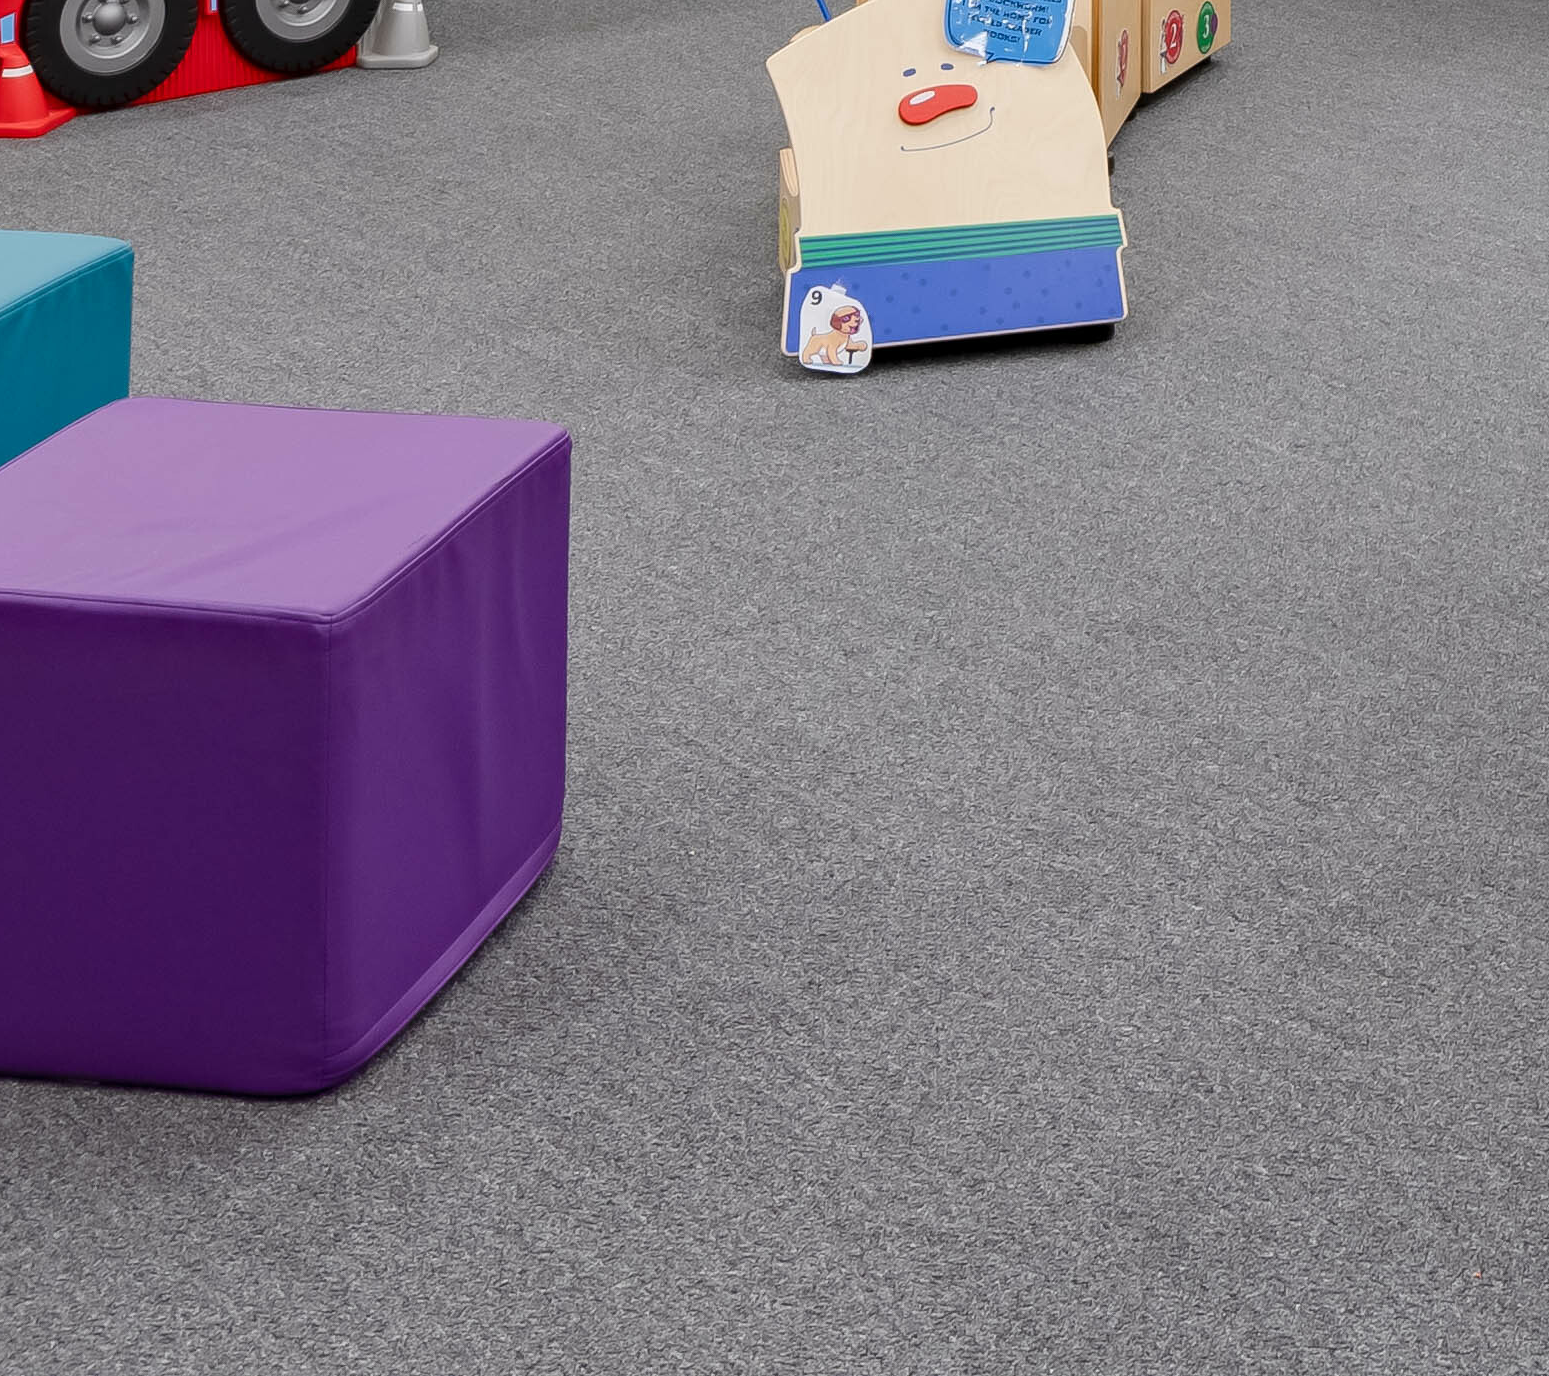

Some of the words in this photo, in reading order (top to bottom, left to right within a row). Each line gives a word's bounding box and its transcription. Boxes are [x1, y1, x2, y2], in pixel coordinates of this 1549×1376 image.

[1169, 23, 1178, 48] 2
[1203, 15, 1210, 39] 3
[811, 290, 822, 305] 9
